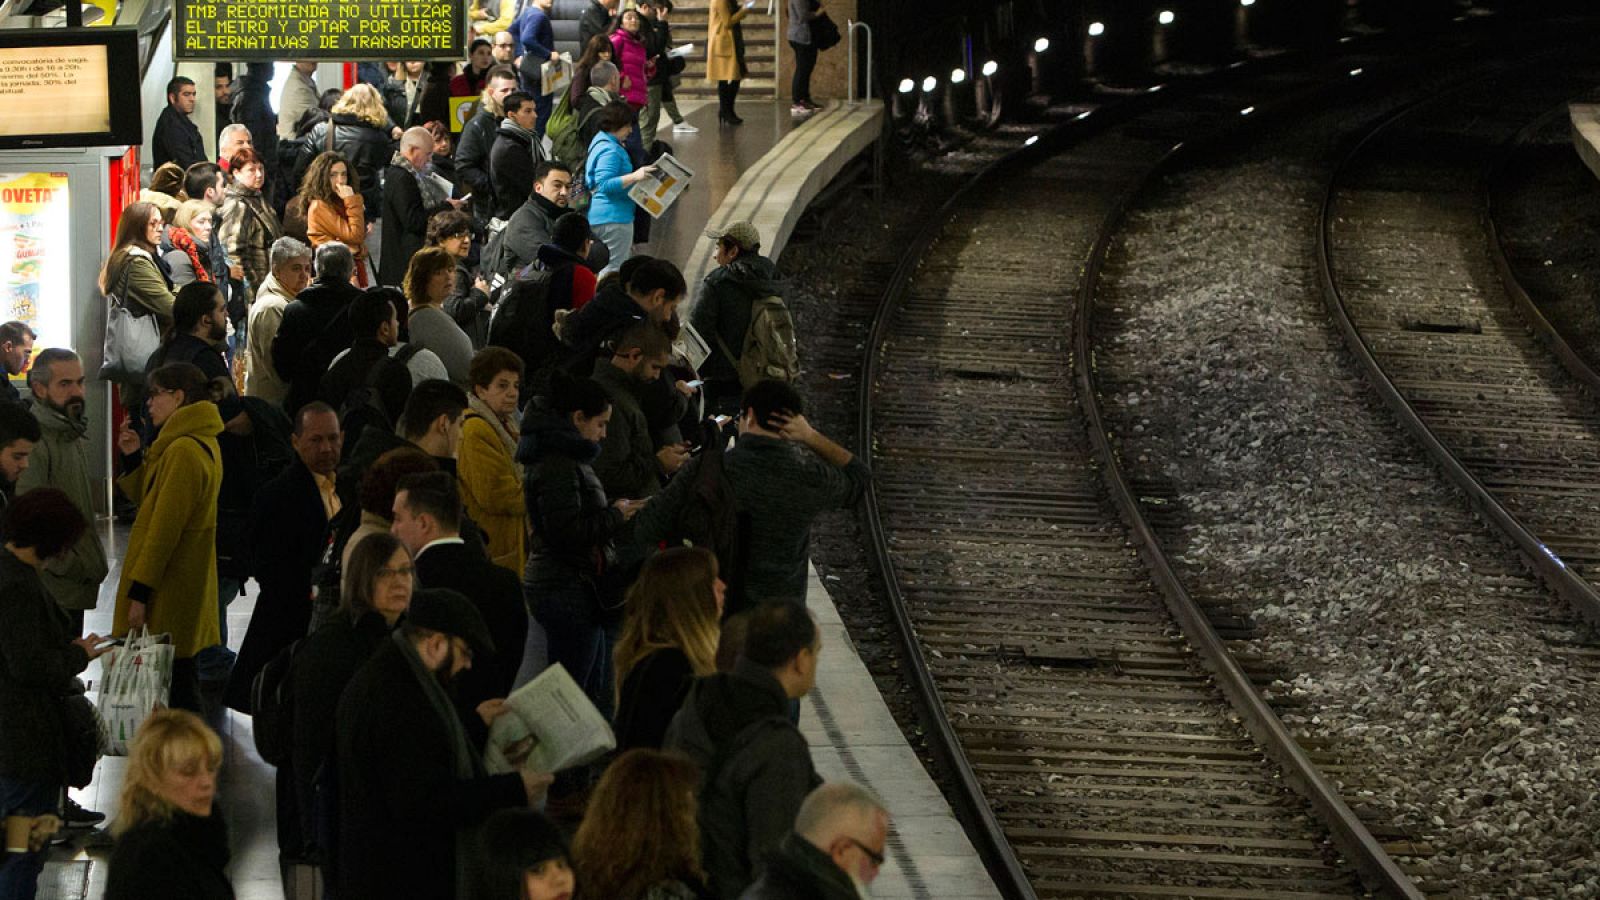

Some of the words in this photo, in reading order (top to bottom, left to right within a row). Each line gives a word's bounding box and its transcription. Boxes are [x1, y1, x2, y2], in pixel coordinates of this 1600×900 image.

[186, 4, 217, 19] TMB
[227, 4, 330, 19] RECOMIENDA
[339, 4, 360, 18] NO
[369, 4, 452, 18] UTILIZAR
[186, 20, 207, 34] EL
[216, 20, 269, 34] METRO
[277, 20, 289, 33] Y
[298, 20, 350, 33] OPTAR
[359, 20, 390, 33] POR
[400, 20, 452, 33] OTRAS
[186, 35, 309, 49] ALTERNATIVAS
[319, 35, 339, 49] DE
[350, 35, 452, 49] TRANSPORTE
